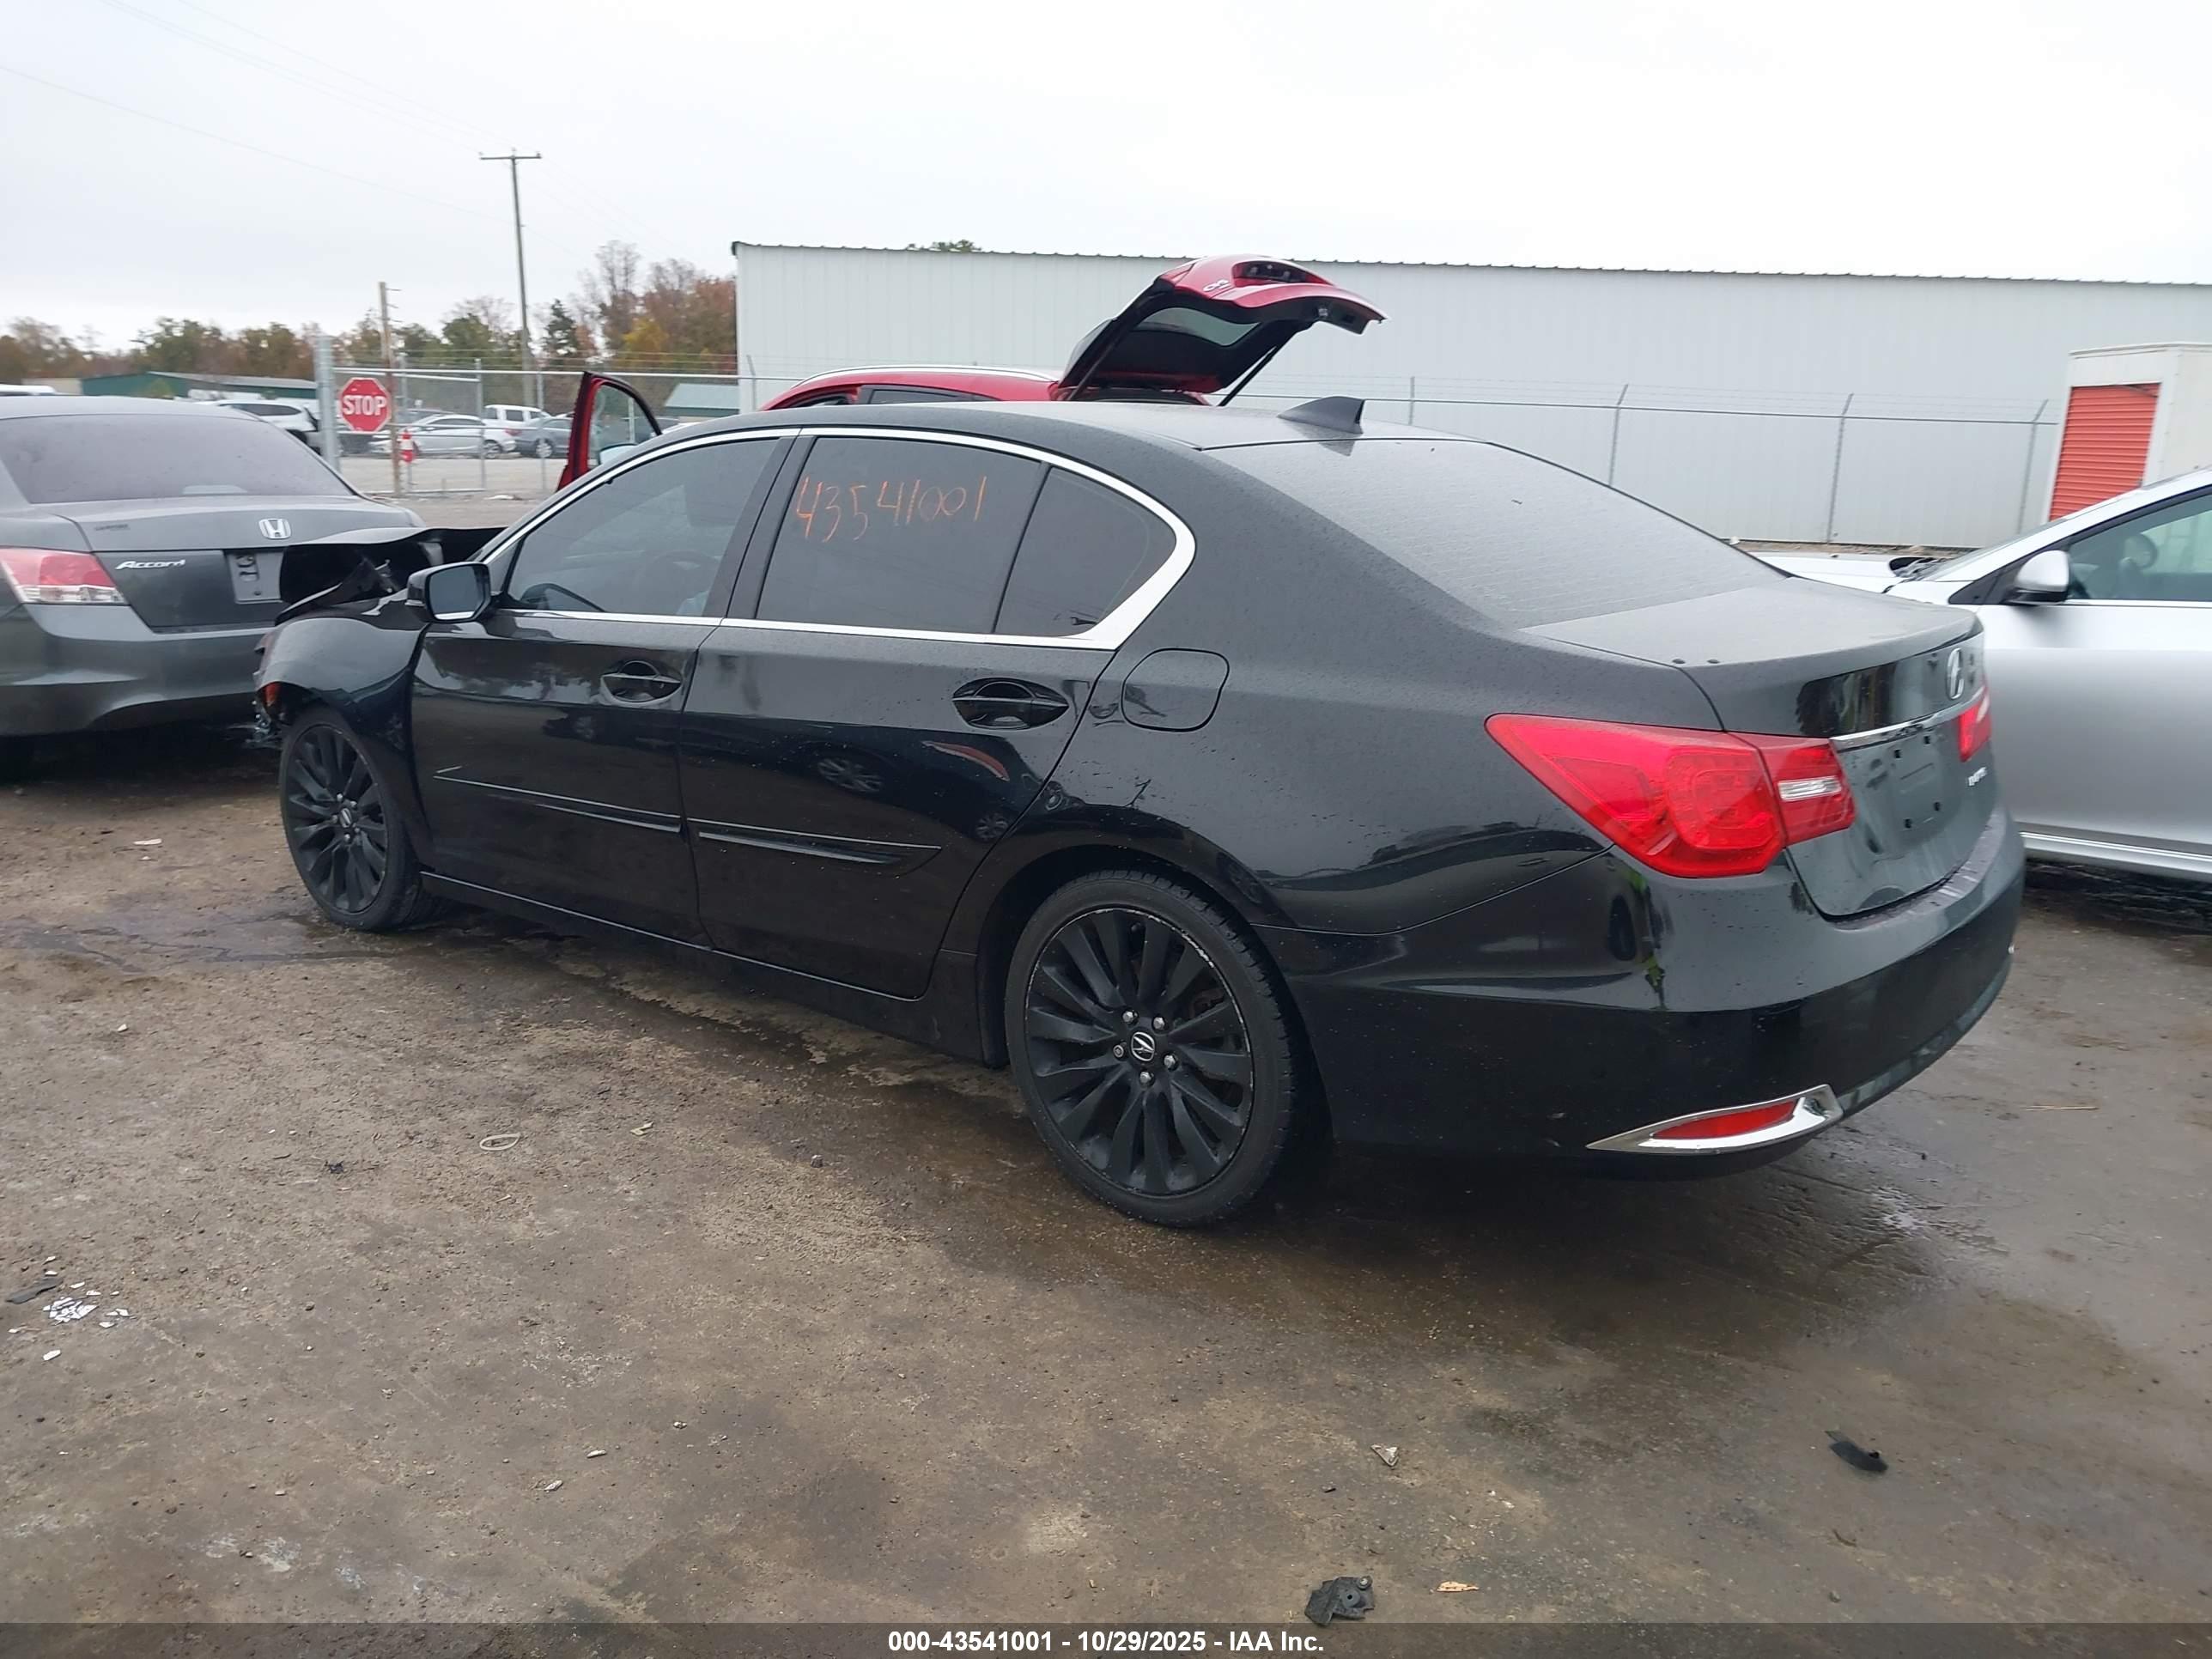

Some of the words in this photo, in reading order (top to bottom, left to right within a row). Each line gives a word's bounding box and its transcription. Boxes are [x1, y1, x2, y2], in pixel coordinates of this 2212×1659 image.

[343, 395, 386, 416] STOP
[795, 475, 988, 543] 43541001
[115, 559, 186, 570] Accord
